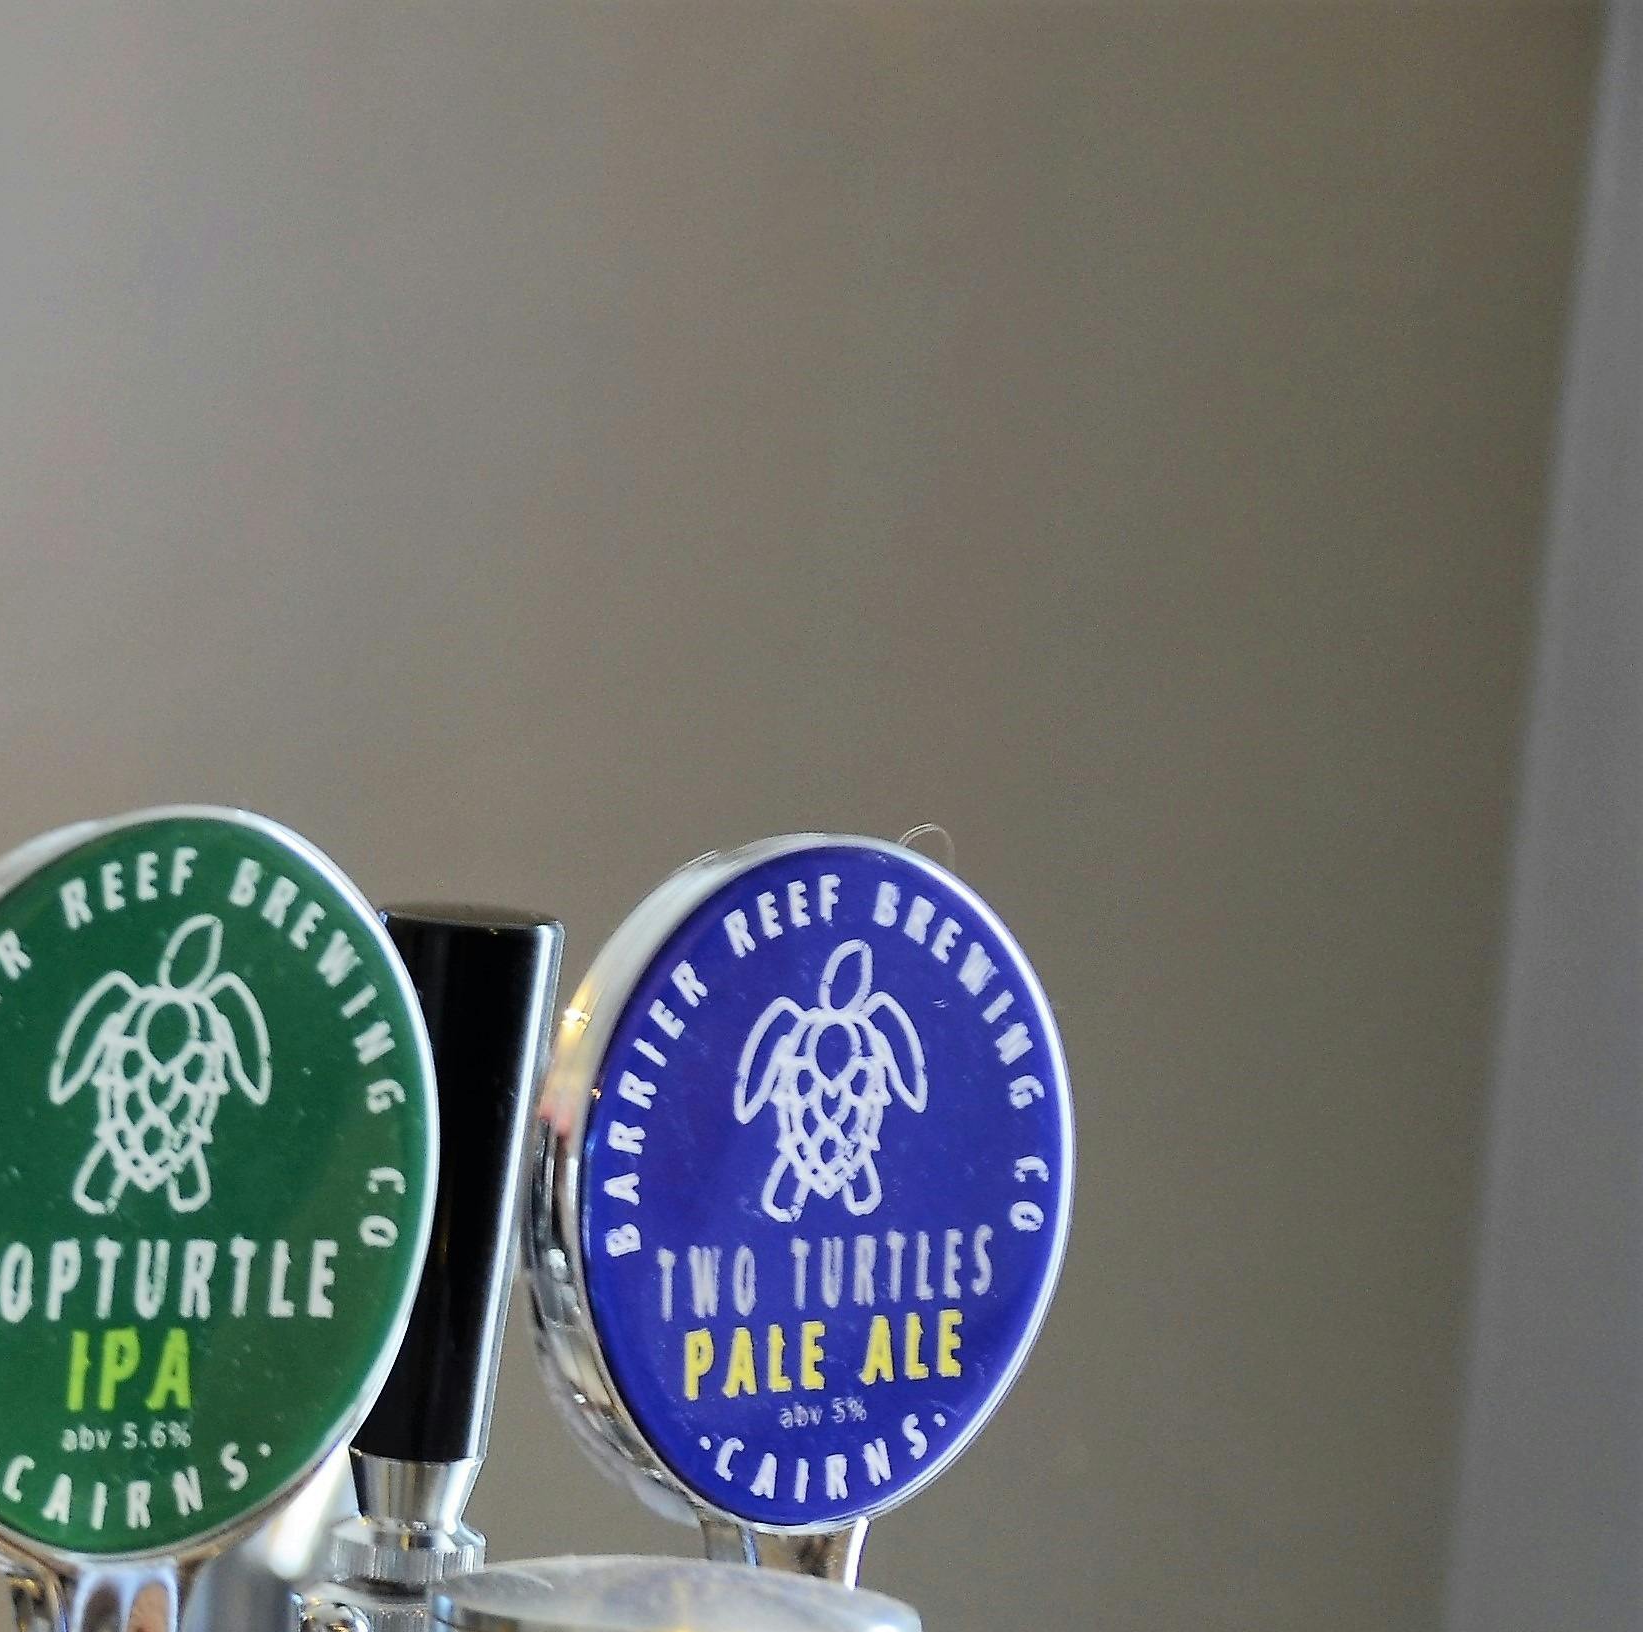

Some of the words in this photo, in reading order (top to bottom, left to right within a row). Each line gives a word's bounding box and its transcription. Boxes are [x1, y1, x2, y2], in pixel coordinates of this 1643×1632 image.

[59, 847, 198, 929] REEF
[228, 858, 406, 1113] BREWING
[359, 1166, 406, 1249] CO
[606, 960, 708, 1257] BARRIER
[723, 873, 841, 953] REEF
[873, 882, 1046, 1110] BREWING
[1009, 1154, 1050, 1232] CO
[657, 1244, 756, 1322] TWO
[791, 1224, 994, 1311] TURTLES
[66, 1327, 192, 1411] IPA
[683, 1320, 825, 1401] PALE
[858, 1308, 963, 1385] ALE
[62, 1426, 111, 1453] abv
[123, 1422, 191, 1449] 5.6%
[715, 1413, 927, 1504] CAIRNS
[780, 1401, 823, 1429] abv
[831, 1397, 867, 1423] 5%
[0, 1442, 249, 1530] CAIRNS
